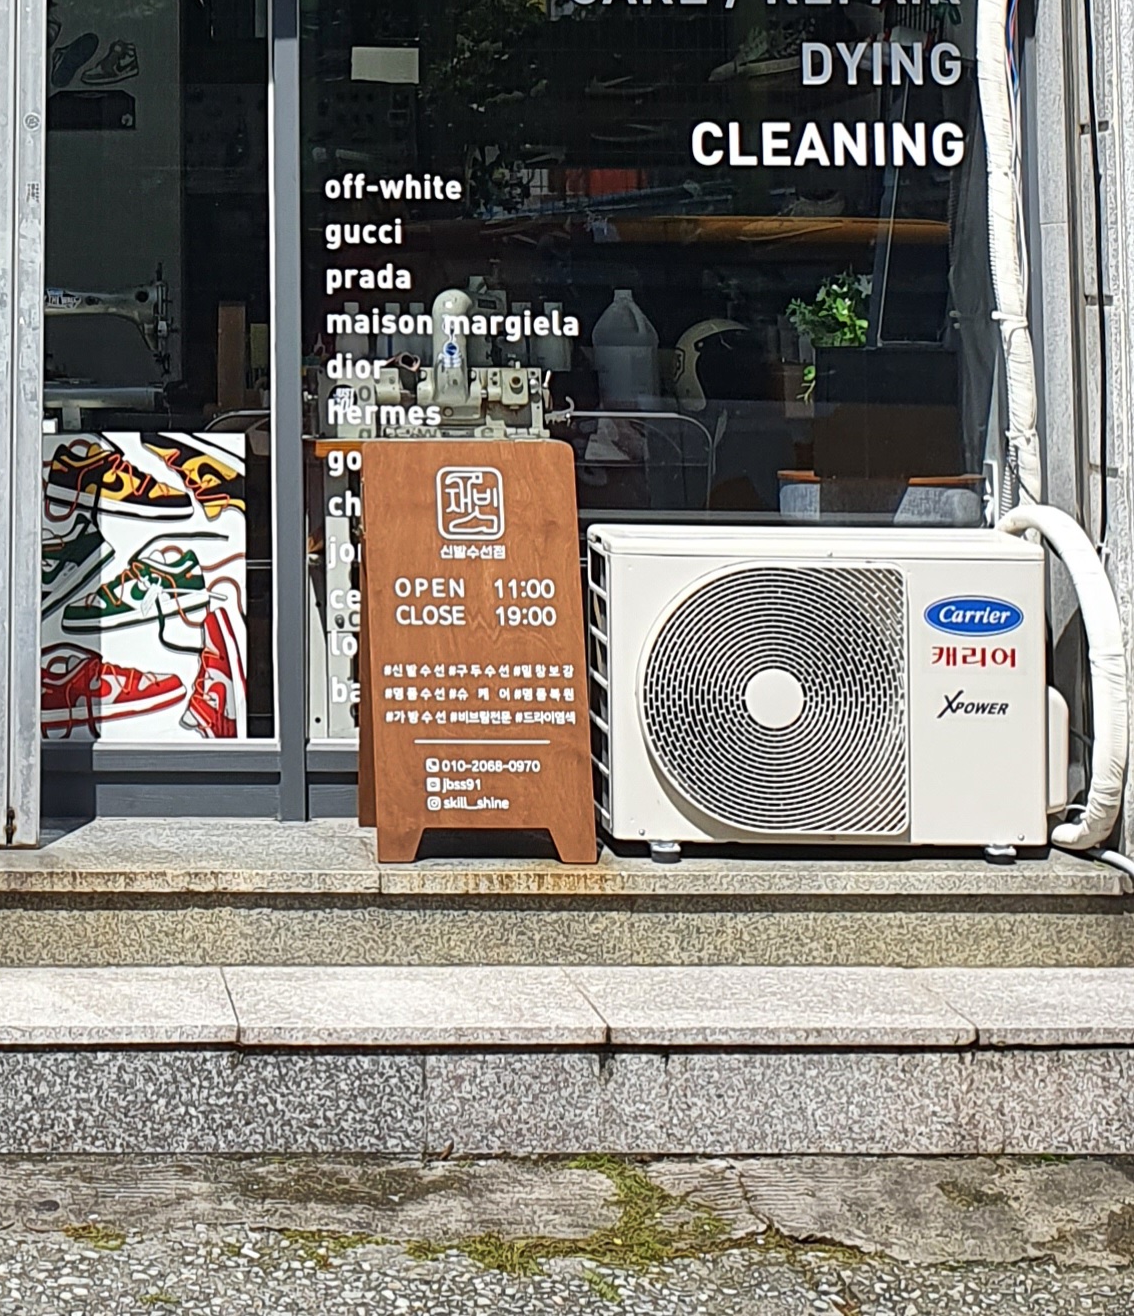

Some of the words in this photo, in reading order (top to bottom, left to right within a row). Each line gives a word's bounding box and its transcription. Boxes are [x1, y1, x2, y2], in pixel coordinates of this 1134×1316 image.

[801, 41, 962, 87] DYING
[691, 121, 966, 168] CLEANING
[324, 173, 463, 201] off-white
[325, 218, 403, 249] gucci
[326, 263, 412, 295] prada
[326, 309, 433, 335] maison
[441, 310, 579, 340] margiela
[327, 353, 387, 380] dior
[327, 398, 442, 425] hermes
[440, 544, 506, 560] 신발수선점
[394, 577, 466, 599] OPEN
[493, 578, 556, 599] 11:00
[395, 604, 466, 626] CLOSE
[495, 605, 557, 627] 19:00
[938, 605, 1011, 624] Carrier
[931, 646, 1016, 668] 캐리어
[936, 689, 1009, 720] XPOWER
[441, 759, 541, 773] 010-2068-0970
[441, 777, 482, 793] jbss91
